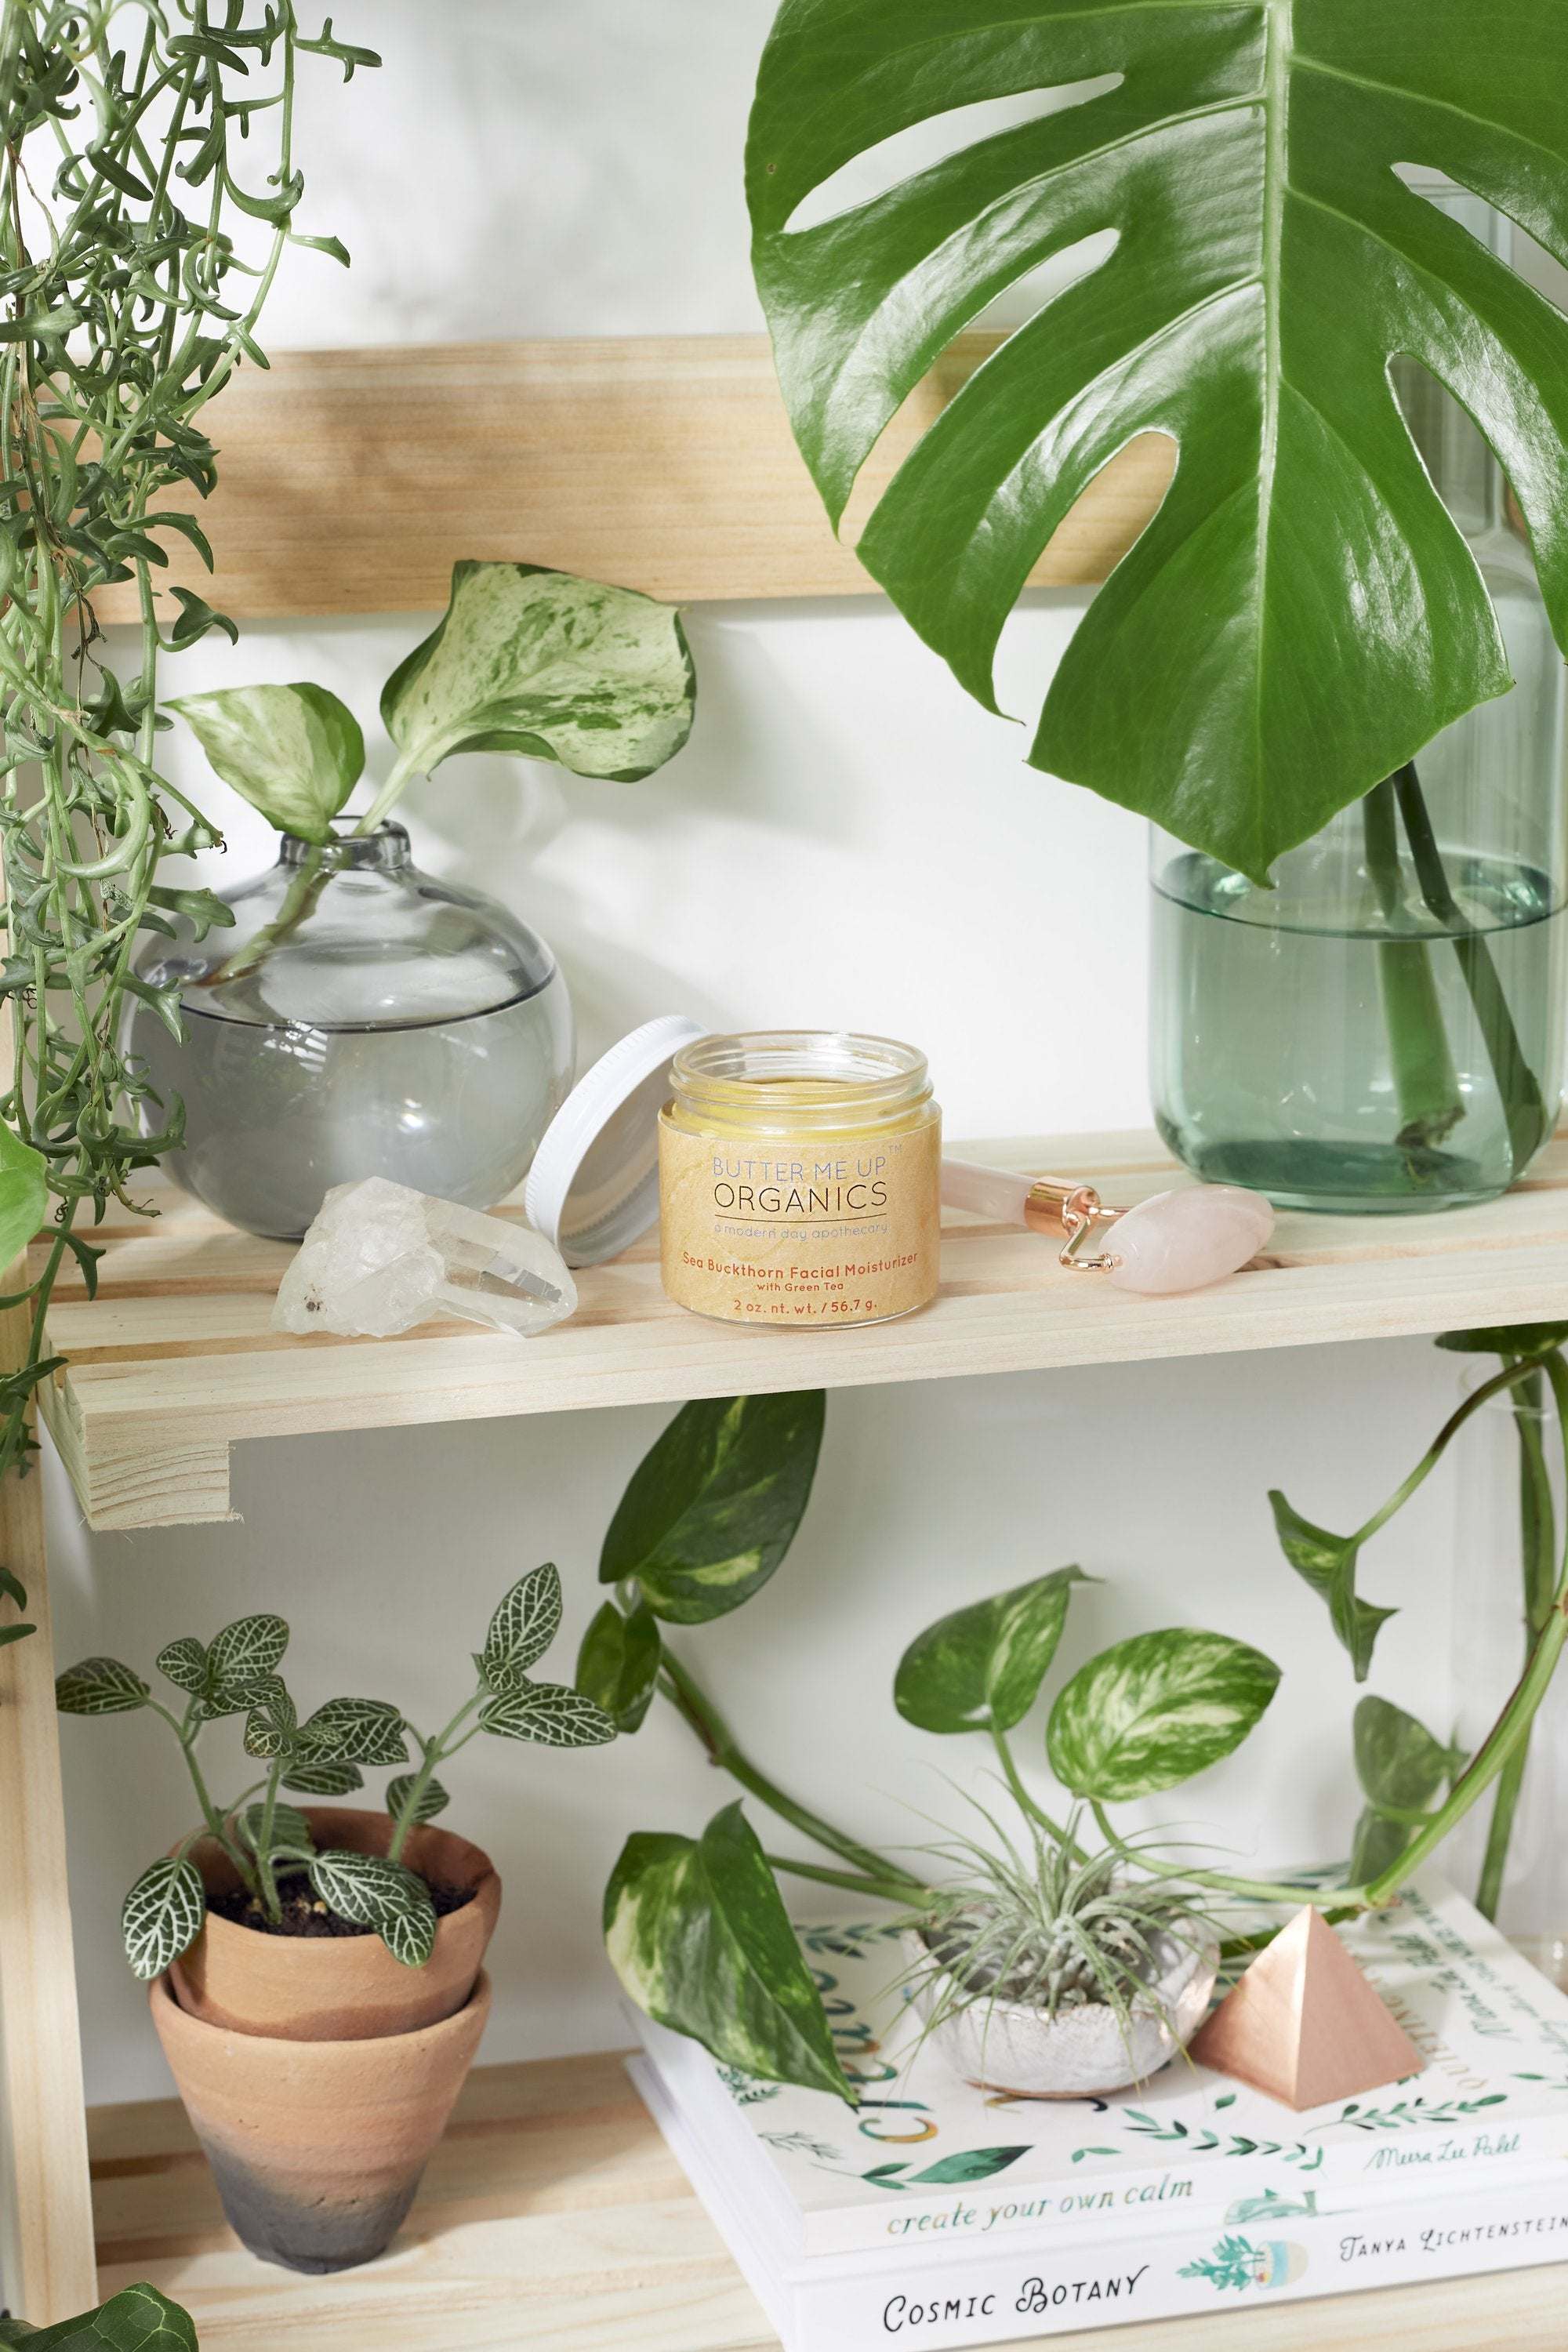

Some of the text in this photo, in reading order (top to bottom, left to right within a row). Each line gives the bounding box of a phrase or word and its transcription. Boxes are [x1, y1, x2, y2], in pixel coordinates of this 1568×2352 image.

[713, 1156, 804, 1181] BUTTER
[815, 1160, 847, 1180] ME
[857, 1156, 887, 1177] UP
[714, 1181, 887, 1213] ORGANICS
[714, 1221, 890, 1242] a modern day apothecary
[683, 1251, 918, 1279] Sea Buckthorn Facial Moisturizer
[757, 1282, 844, 1292] with Green Tea
[734, 1300, 742, 1310] 2
[746, 1303, 767, 1312] oz.
[771, 1302, 790, 1314] nt.
[794, 1302, 817, 1315] wt.
[887, 2173, 1193, 2235] create your own calm
[1340, 2235, 1407, 2262] TANYA
[884, 2265, 1150, 2332] COSMIC BOTANY
